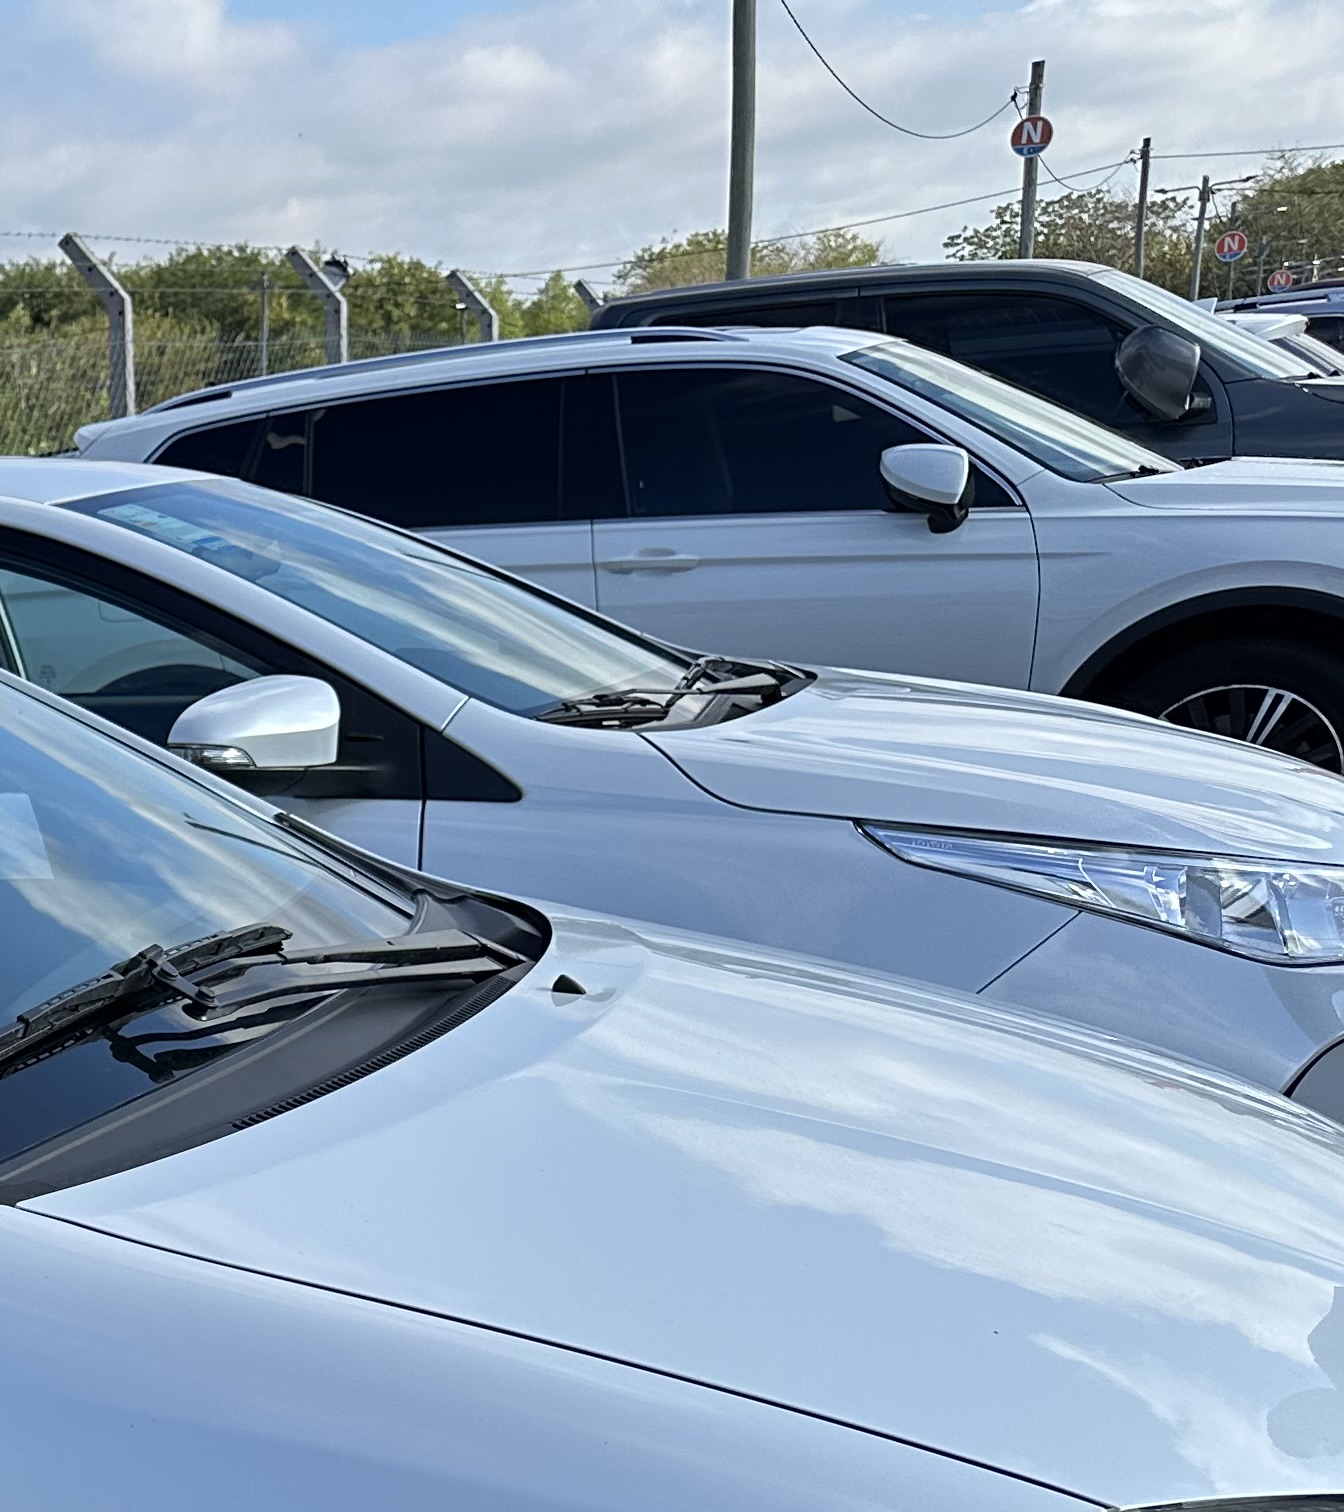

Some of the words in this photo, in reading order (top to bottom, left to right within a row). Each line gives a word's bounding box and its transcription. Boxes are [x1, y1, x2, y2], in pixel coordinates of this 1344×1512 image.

[1021, 120, 1043, 144] N
[1223, 234, 1240, 253] N
[1273, 273, 1287, 286] N
